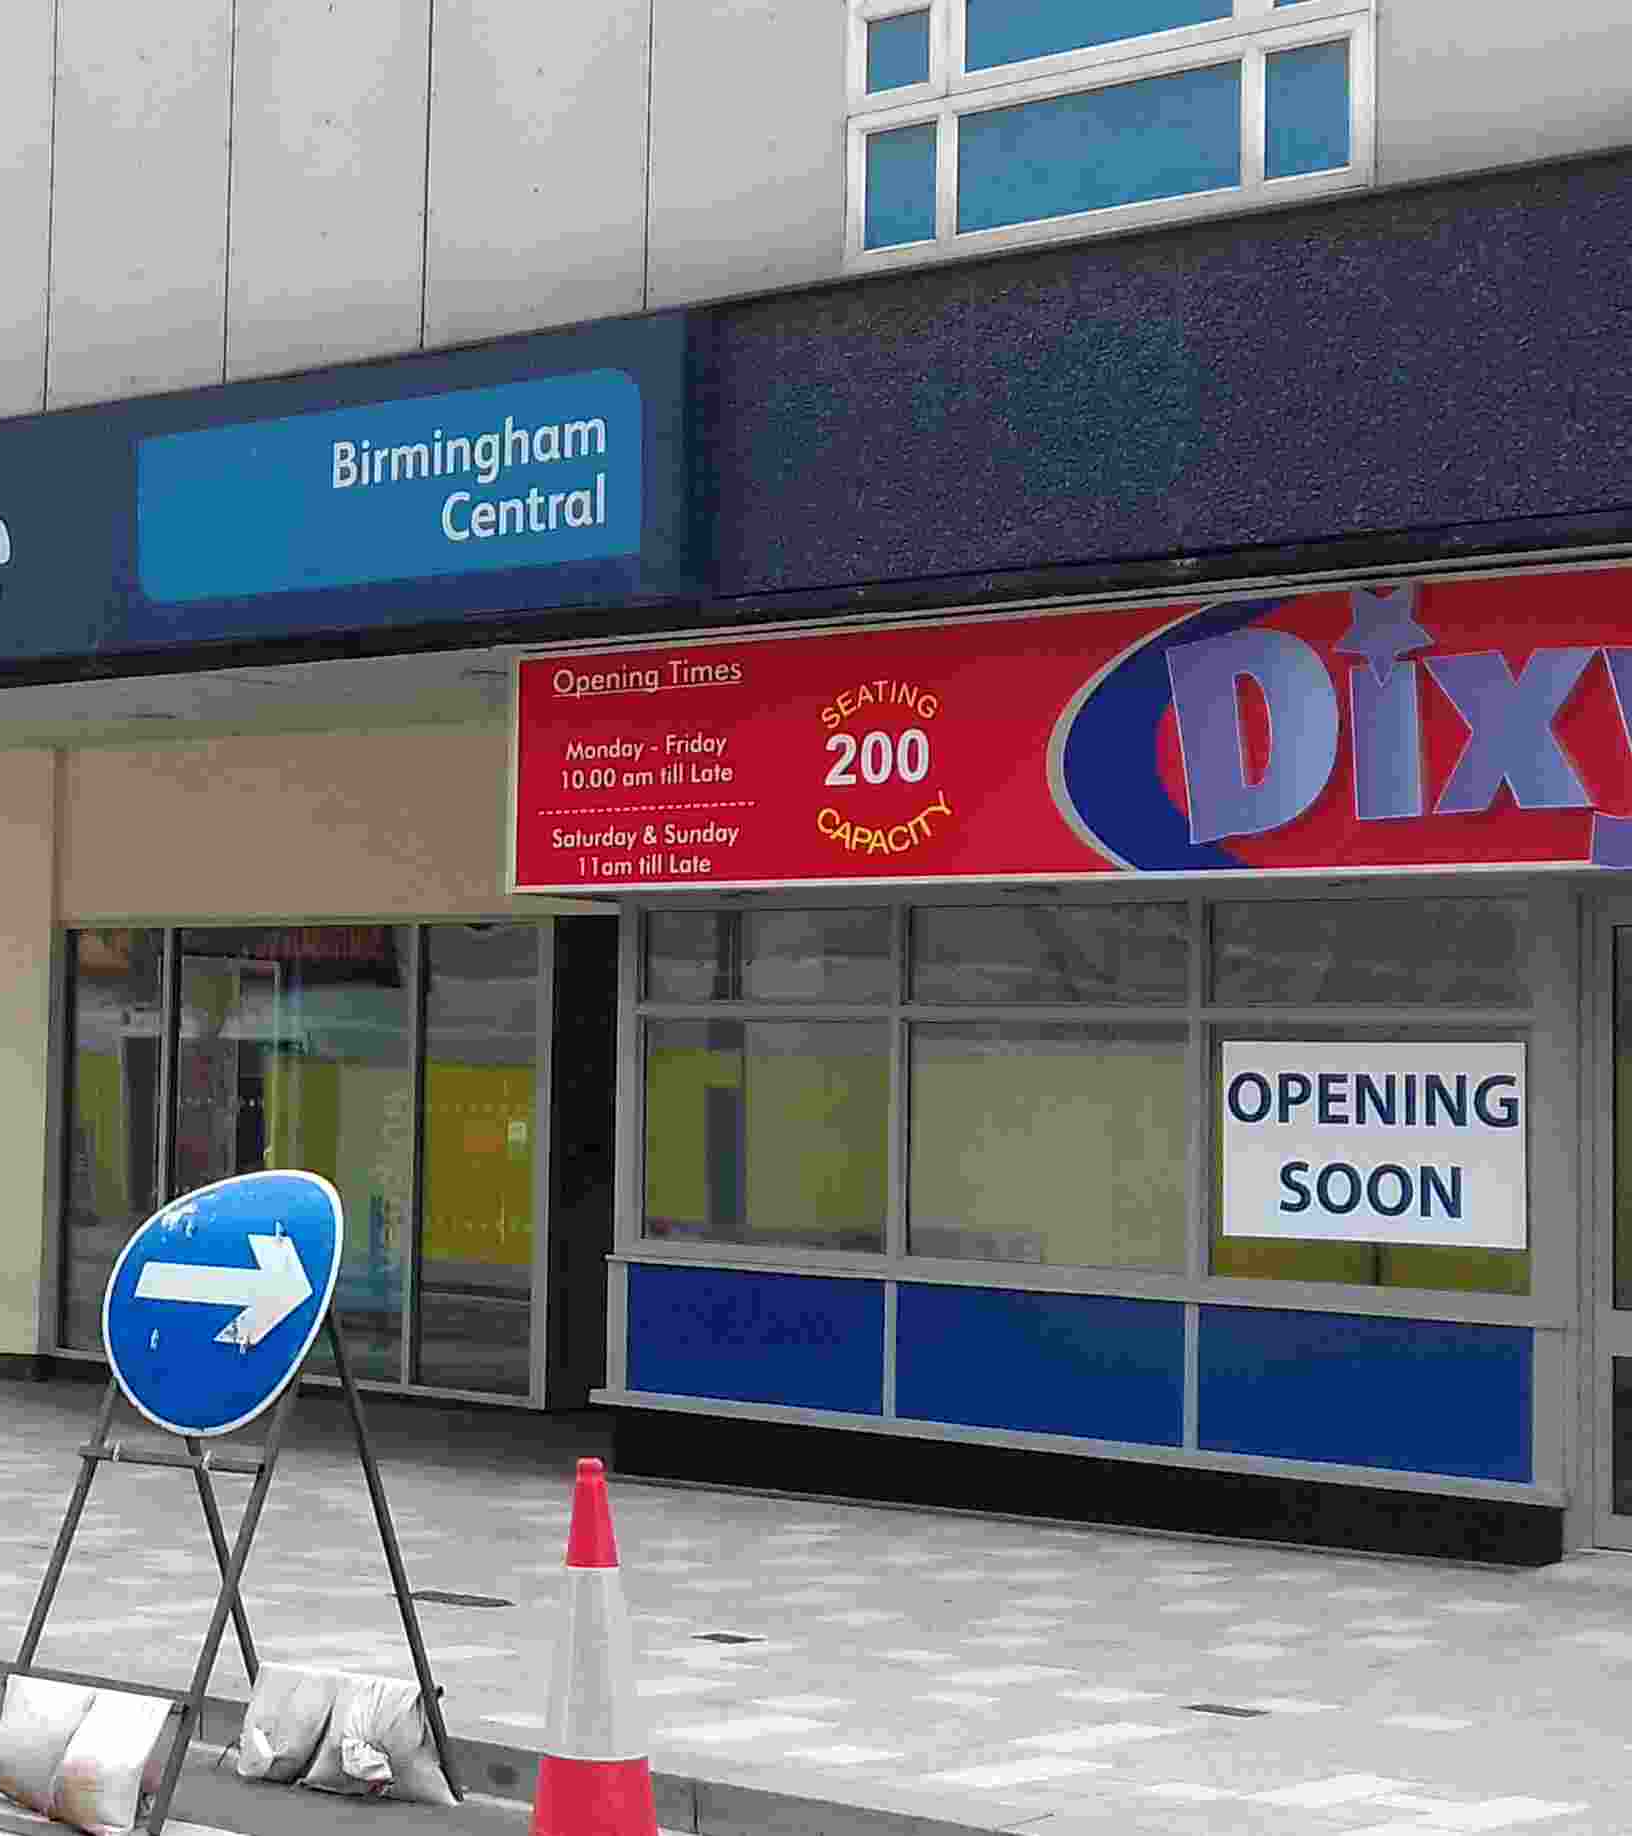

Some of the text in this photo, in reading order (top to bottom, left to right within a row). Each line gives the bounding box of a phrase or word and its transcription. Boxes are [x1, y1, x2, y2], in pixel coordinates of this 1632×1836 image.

[332, 416, 607, 488] Birmingham
[441, 474, 607, 541] Central
[552, 659, 743, 698] Opening Times
[821, 680, 938, 728] SEATING
[565, 737, 644, 761] Monday
[665, 731, 727, 756] Friday
[1165, 583, 1632, 870] Dix
[561, 763, 734, 790] 10.00 am till Late
[824, 727, 929, 786] 200
[552, 821, 740, 850] Saturday & Sunday
[817, 790, 952, 854] CAPACITY
[578, 854, 712, 876] 11am till Late
[1227, 1072, 1519, 1128] OPENING
[1279, 1161, 1463, 1219] SOON
